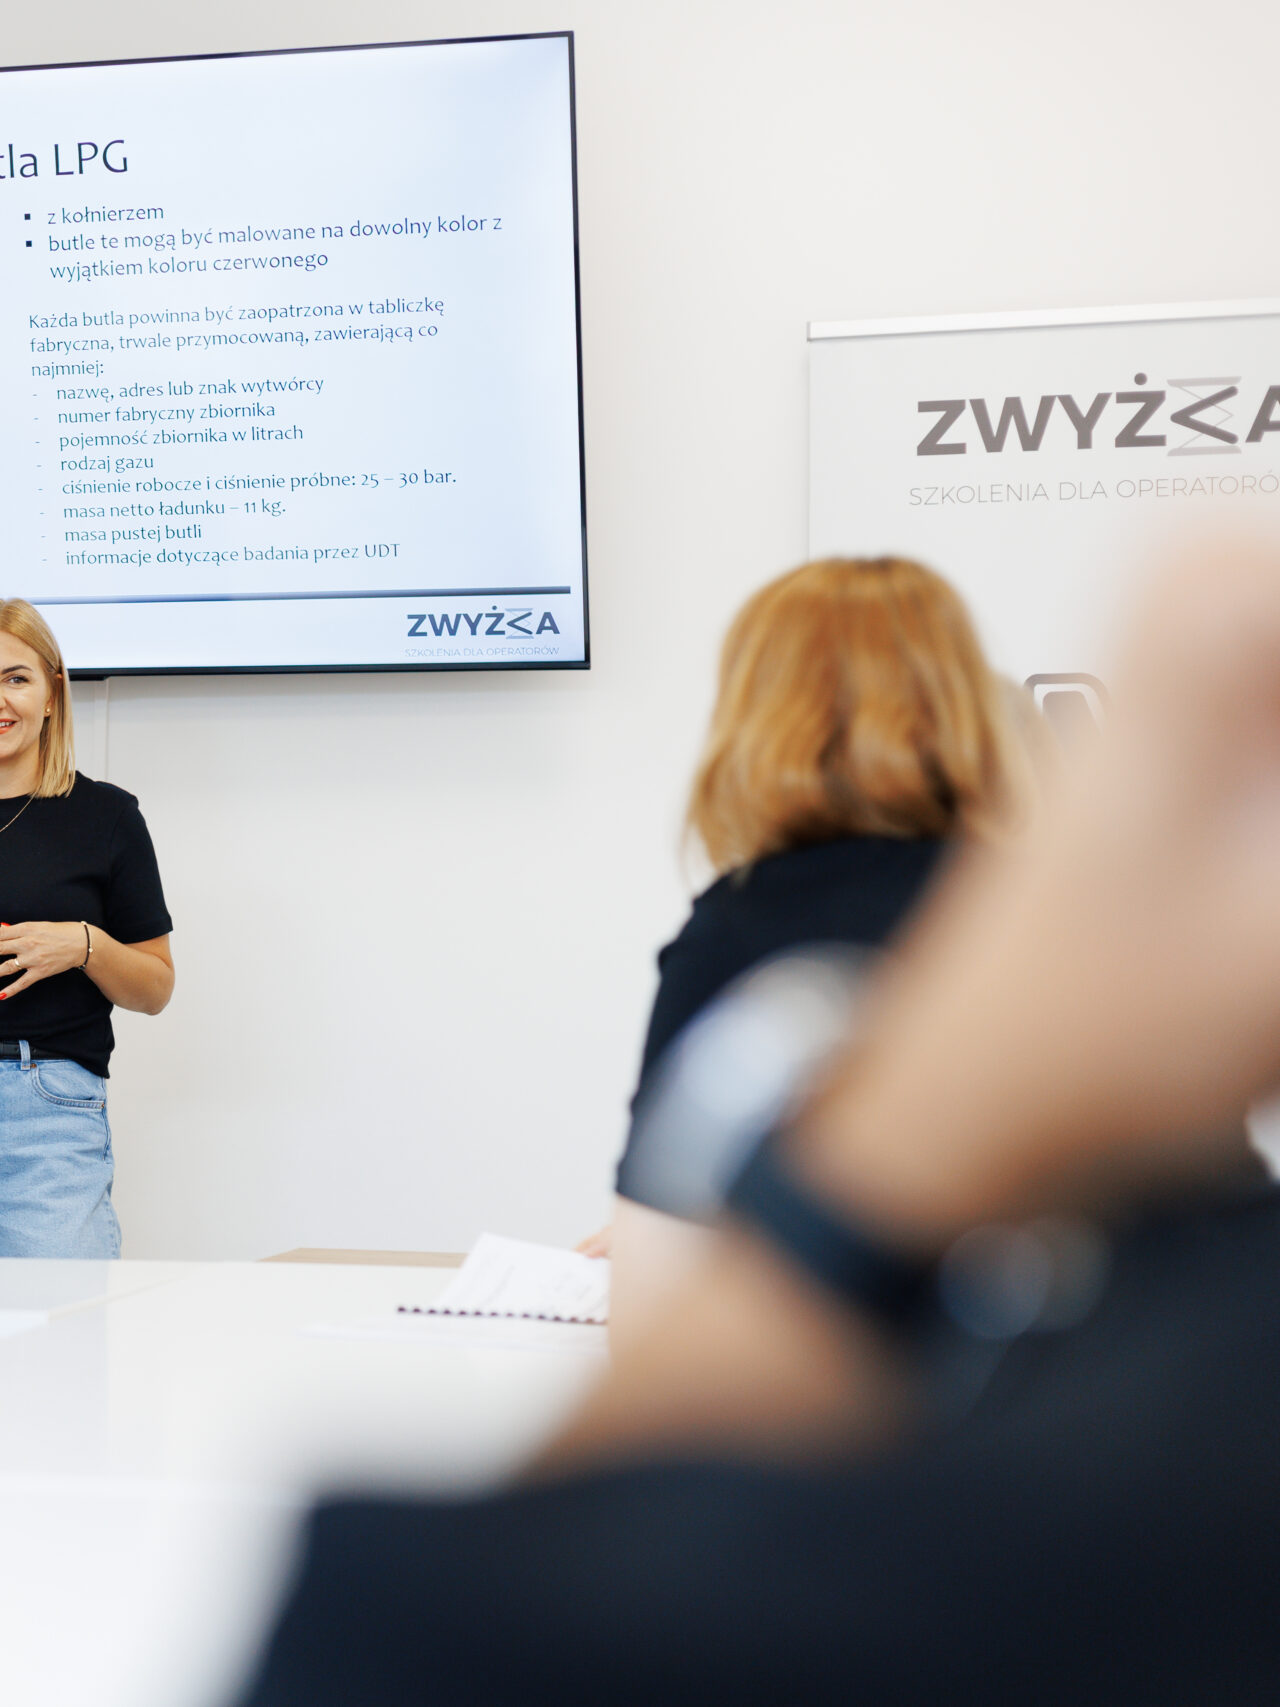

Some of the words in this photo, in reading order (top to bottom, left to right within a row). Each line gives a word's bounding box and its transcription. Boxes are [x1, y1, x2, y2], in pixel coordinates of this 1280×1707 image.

[53, 139, 129, 177] LPG
[47, 212, 57, 225] z
[61, 205, 165, 225] kołnierzem
[48, 232, 95, 252] butle
[100, 234, 119, 249] te
[124, 233, 177, 252] mogą
[181, 227, 214, 250] być
[218, 225, 316, 244] malowane
[321, 225, 344, 239] na
[349, 216, 433, 239] dowolny
[437, 214, 488, 233] kolor
[492, 217, 503, 231] z
[49, 259, 143, 284] wyjątkiem
[148, 255, 207, 275] koloru
[212, 253, 329, 272] czerwonego
[29, 311, 78, 329] Każda
[82, 310, 125, 327] butla
[128, 308, 200, 329] powinna
[204, 305, 234, 326] być
[238, 303, 344, 324] zaopatrzona
[348, 303, 364, 316] w
[367, 296, 445, 317] tabliczkę
[29, 336, 115, 356] fabryczna,
[118, 332, 172, 350] trwale
[176, 330, 310, 352] przymocowaną,
[314, 323, 413, 344] zawierającą
[417, 325, 439, 337] co
[31, 359, 104, 381] najmniej:
[56, 387, 115, 404] nazwę,
[118, 381, 165, 398] adres
[167, 379, 194, 397] lub
[198, 378, 238, 396] znak
[240, 375, 324, 398] wytwórcy
[57, 411, 112, 424] numer
[114, 405, 195, 425] fabryczny
[199, 401, 276, 420] zbiornika
[59, 429, 149, 453] pojemność
[152, 426, 228, 445] zbiornika
[231, 430, 247, 442] w
[251, 424, 304, 441] litrach
[60, 455, 111, 474] rodzaj
[114, 457, 154, 474] gazu
[61, 478, 131, 495] ciśnienie
[135, 476, 202, 493] robocze
[206, 475, 211, 491] i
[214, 473, 286, 491] ciśnienie
[290, 471, 356, 493] próbne:
[360, 473, 380, 489] 25
[399, 472, 419, 489] 30
[423, 468, 457, 484] bar.
[909, 482, 1049, 506] SZKOLENIA
[1058, 480, 1108, 501] DLA
[1115, 469, 1280, 498] OPERATORÓ
[63, 507, 106, 519] masa
[109, 503, 155, 518] netto
[158, 499, 225, 516] ładunku
[243, 501, 257, 514] 11
[261, 497, 287, 518] kg.
[64, 530, 107, 543] masa
[111, 524, 161, 545] pustej
[164, 523, 202, 540] butli
[65, 548, 152, 568] informacje
[156, 547, 240, 567] dotyczące
[243, 545, 309, 561] badania
[313, 547, 359, 564] przez
[364, 543, 401, 559] UDT
[404, 648, 462, 657] SZKOLENIA
[463, 647, 485, 657] DLA
[485, 645, 560, 656] OPERATORÓW
